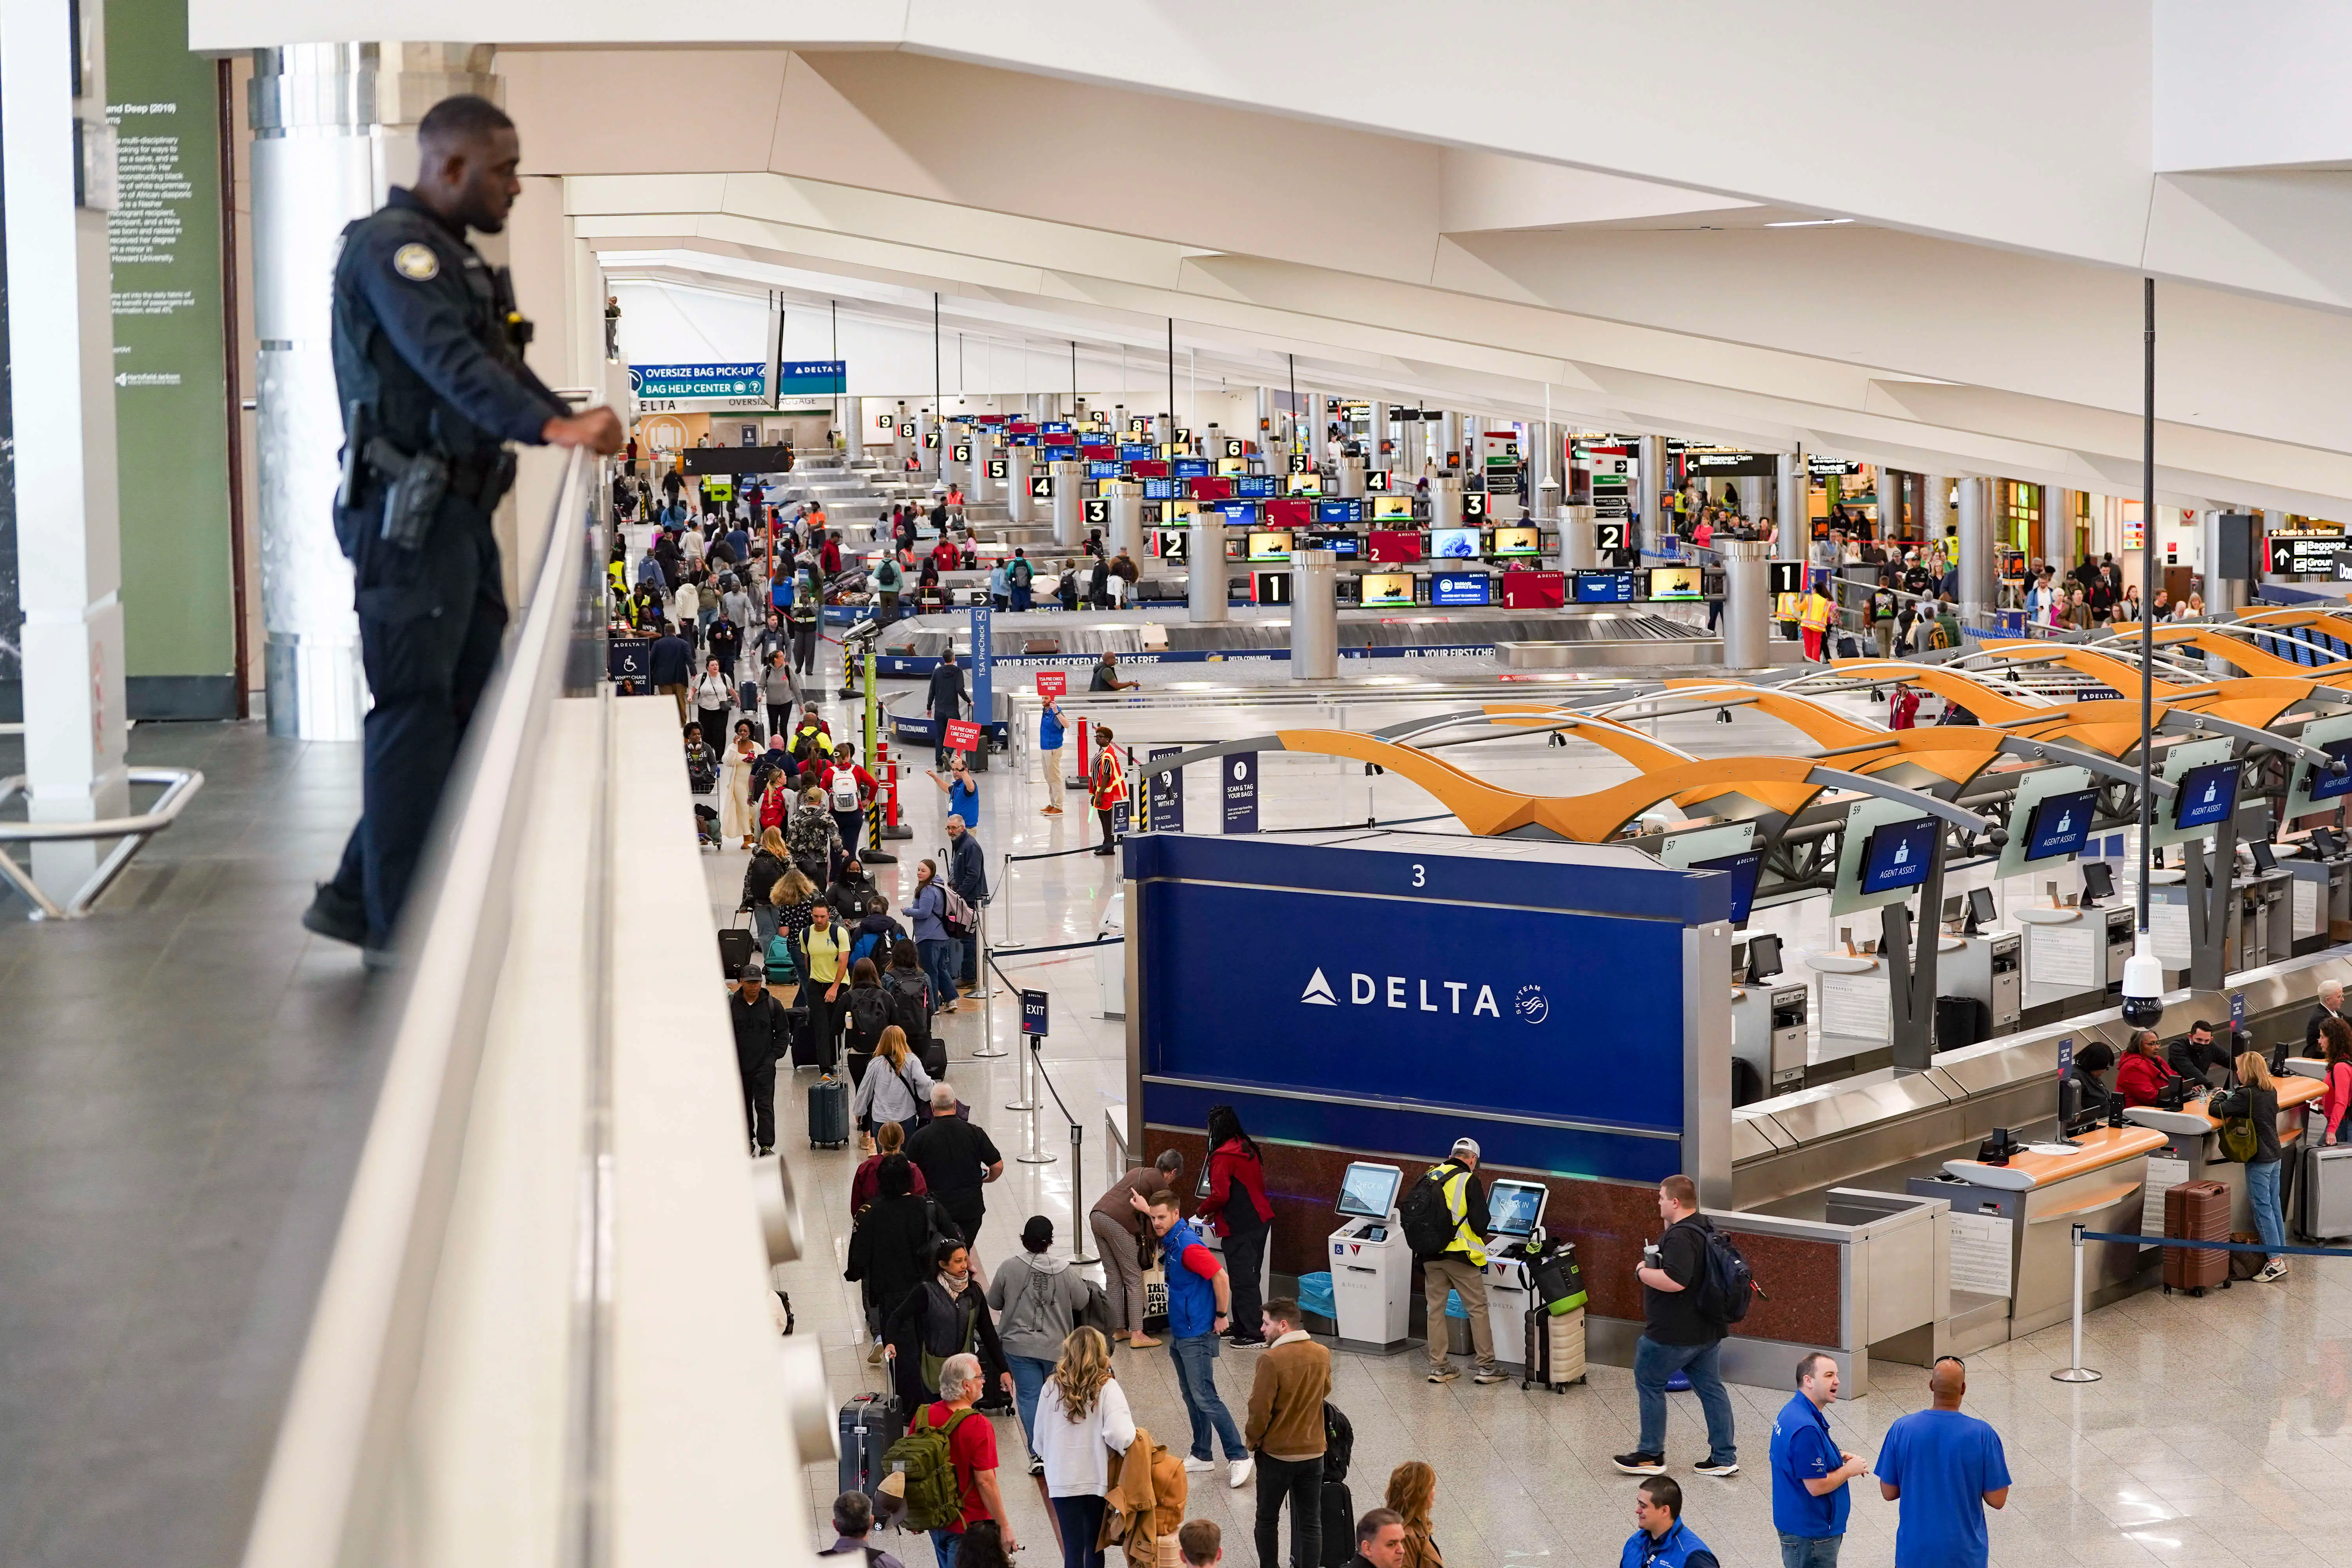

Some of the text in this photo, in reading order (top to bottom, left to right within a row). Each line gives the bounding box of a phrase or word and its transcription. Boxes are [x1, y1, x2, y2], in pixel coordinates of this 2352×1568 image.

[124, 104, 149, 114] Deep
[150, 103, 176, 114] (2019)
[113, 254, 174, 263] Howard University.
[646, 367, 754, 377] OVERSIZE BAG PICK-UP
[646, 383, 731, 394] BAG HELP CENTER
[881, 416, 890, 427] 9
[1094, 412, 1102, 422] 9
[903, 425, 913, 437] 8
[1133, 420, 1142, 431] 8
[928, 435, 938, 447] 7
[1178, 430, 1188, 442] 7
[956, 446, 968, 460] 6
[1229, 441, 1240, 455] 6
[992, 462, 1004, 477] 5
[1369, 473, 1383, 489] 4
[1035, 479, 1049, 495] 4
[1192, 490, 1199, 499] 4
[1467, 495, 1481, 514] 3
[1089, 503, 1104, 521] 3
[1267, 515, 1274, 525] 3
[1602, 526, 1618, 548] 2
[2308, 541, 2347, 550] Baggage
[1371, 549, 1379, 561] 2
[2307, 558, 2333, 566] Groun
[1781, 566, 1791, 590] 1
[1270, 576, 1279, 601] 1
[1507, 592, 1513, 606] 1
[898, 724, 927, 733] DELTA.COM/AMEX
[1239, 766, 1242, 776] 1
[1163, 774, 1169, 784] 2
[2324, 777, 2350, 788] AGENT ASSIST
[1154, 793, 1167, 801] DROP
[1853, 806, 1861, 814] 59
[2207, 804, 2222, 813] ASSIST
[1743, 827, 1752, 836] 58
[1666, 841, 1675, 850] 57
[2043, 834, 2076, 846] AGENT ASSIST
[1412, 864, 1425, 887] 3
[1880, 865, 1916, 879] AGENT ASSIST
[1351, 973, 1541, 1018] DELTA SKYTEAM
[1027, 1004, 1044, 1016] EXIT
[1356, 1181, 1376, 1189] CHECK
[1500, 1199, 1521, 1208] CHECK
